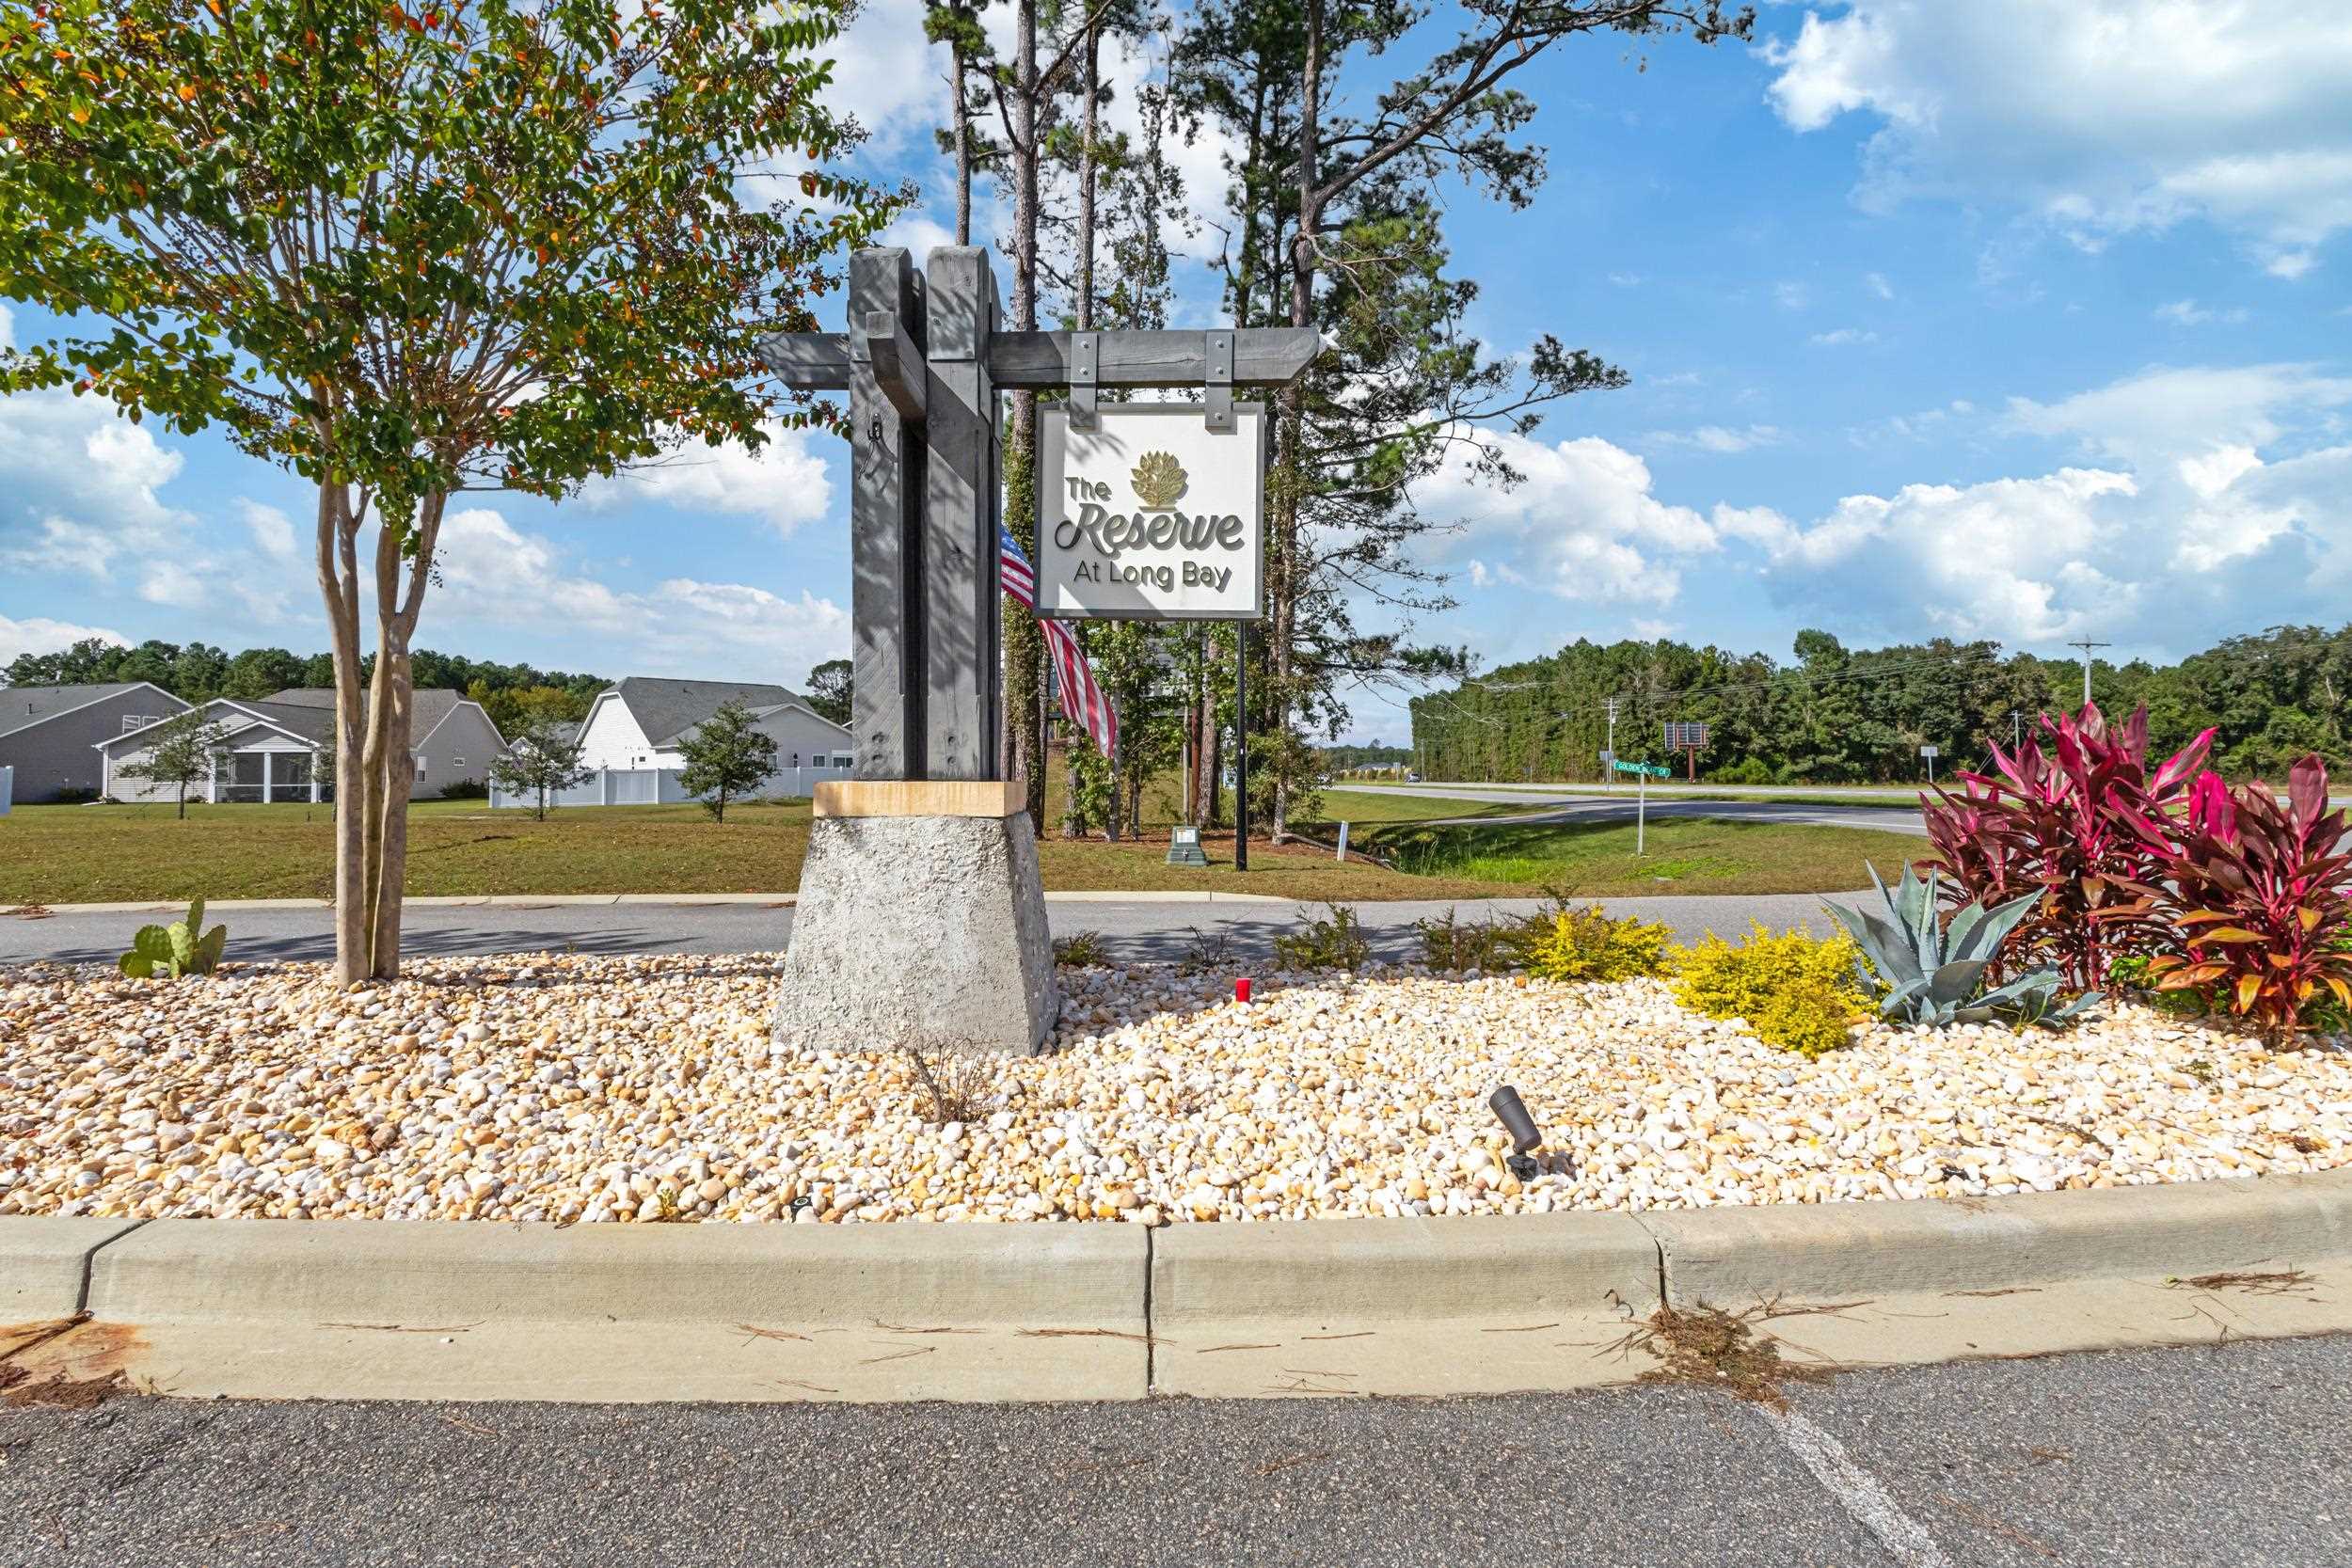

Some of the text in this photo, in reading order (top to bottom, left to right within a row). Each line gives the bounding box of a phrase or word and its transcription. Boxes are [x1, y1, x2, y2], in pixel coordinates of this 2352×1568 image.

[1064, 476, 1112, 501] The
[1055, 502, 1245, 560] Reserve
[1073, 560, 1232, 593] At Long Bay
[1618, 761, 1641, 771] GOLDEN
